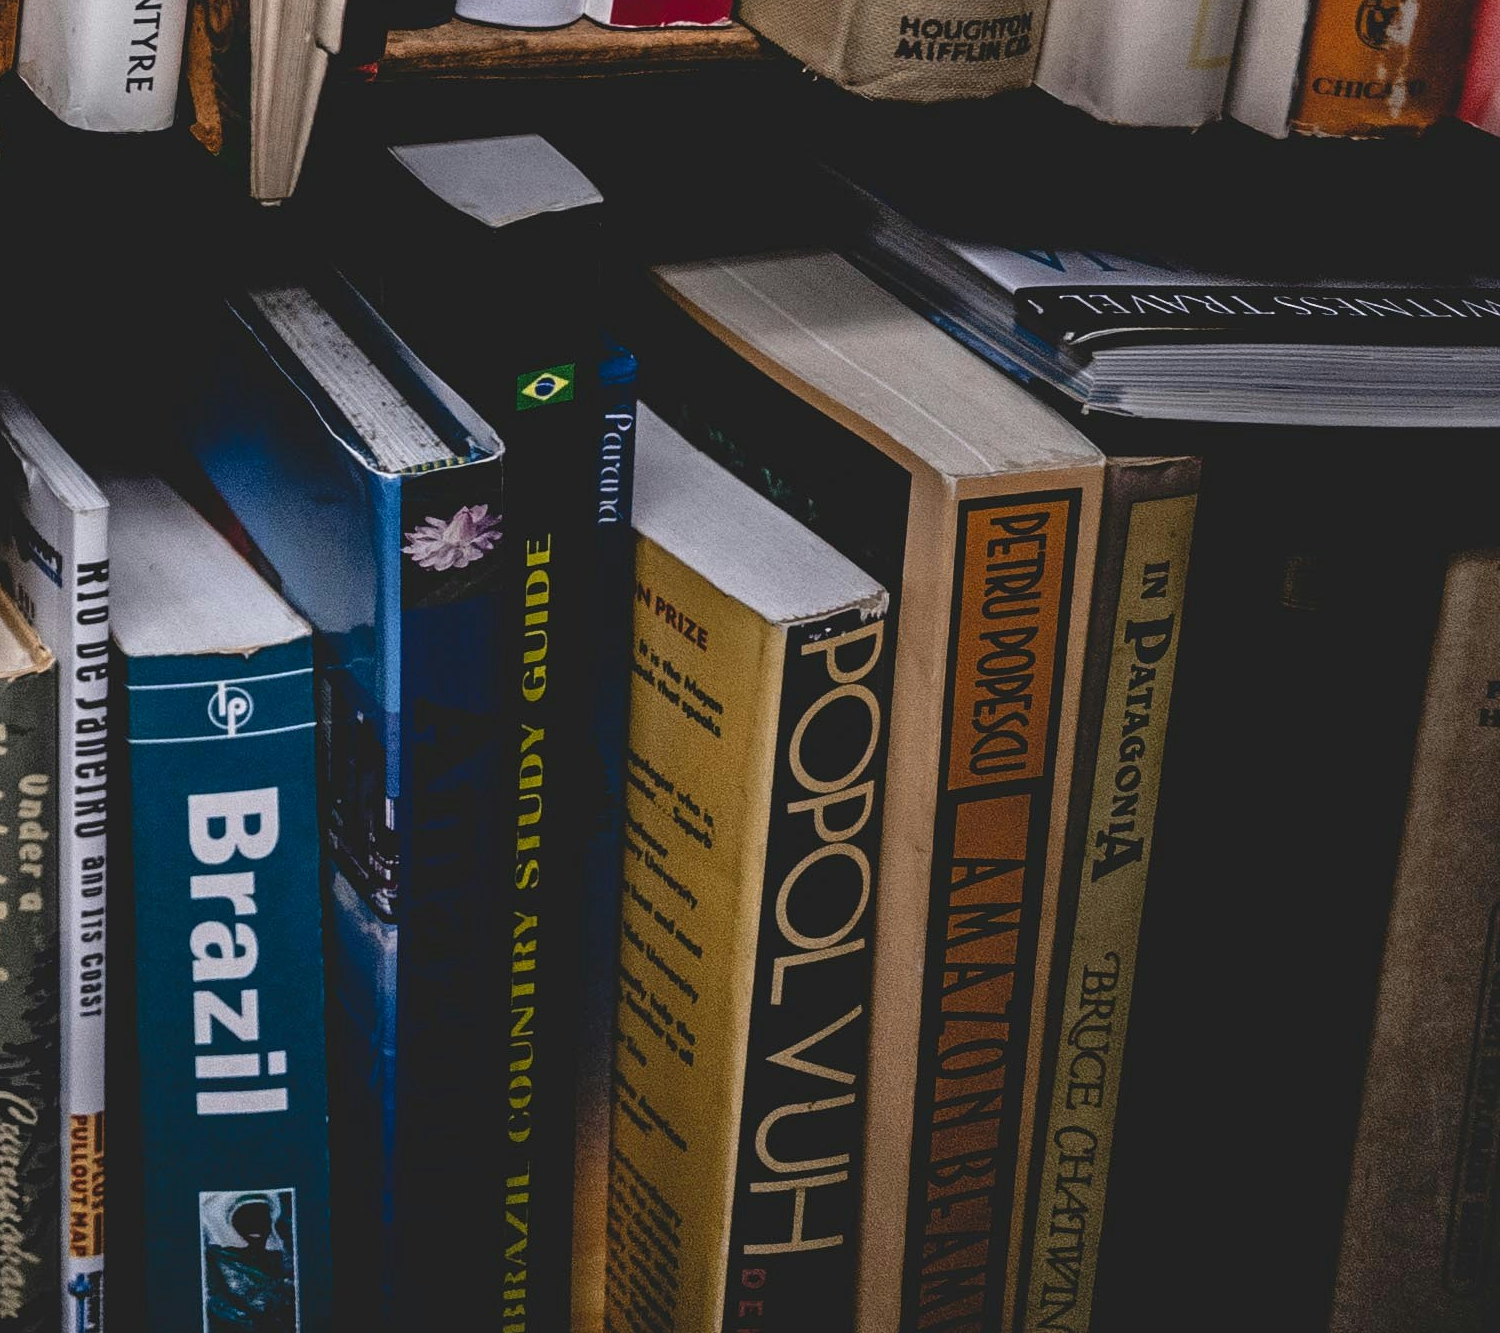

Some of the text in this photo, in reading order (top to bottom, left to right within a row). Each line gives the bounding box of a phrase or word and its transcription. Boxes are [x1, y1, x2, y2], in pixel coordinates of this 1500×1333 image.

[188, 787, 288, 1116] Brazil
[744, 625, 884, 1258] POPOL VUH
